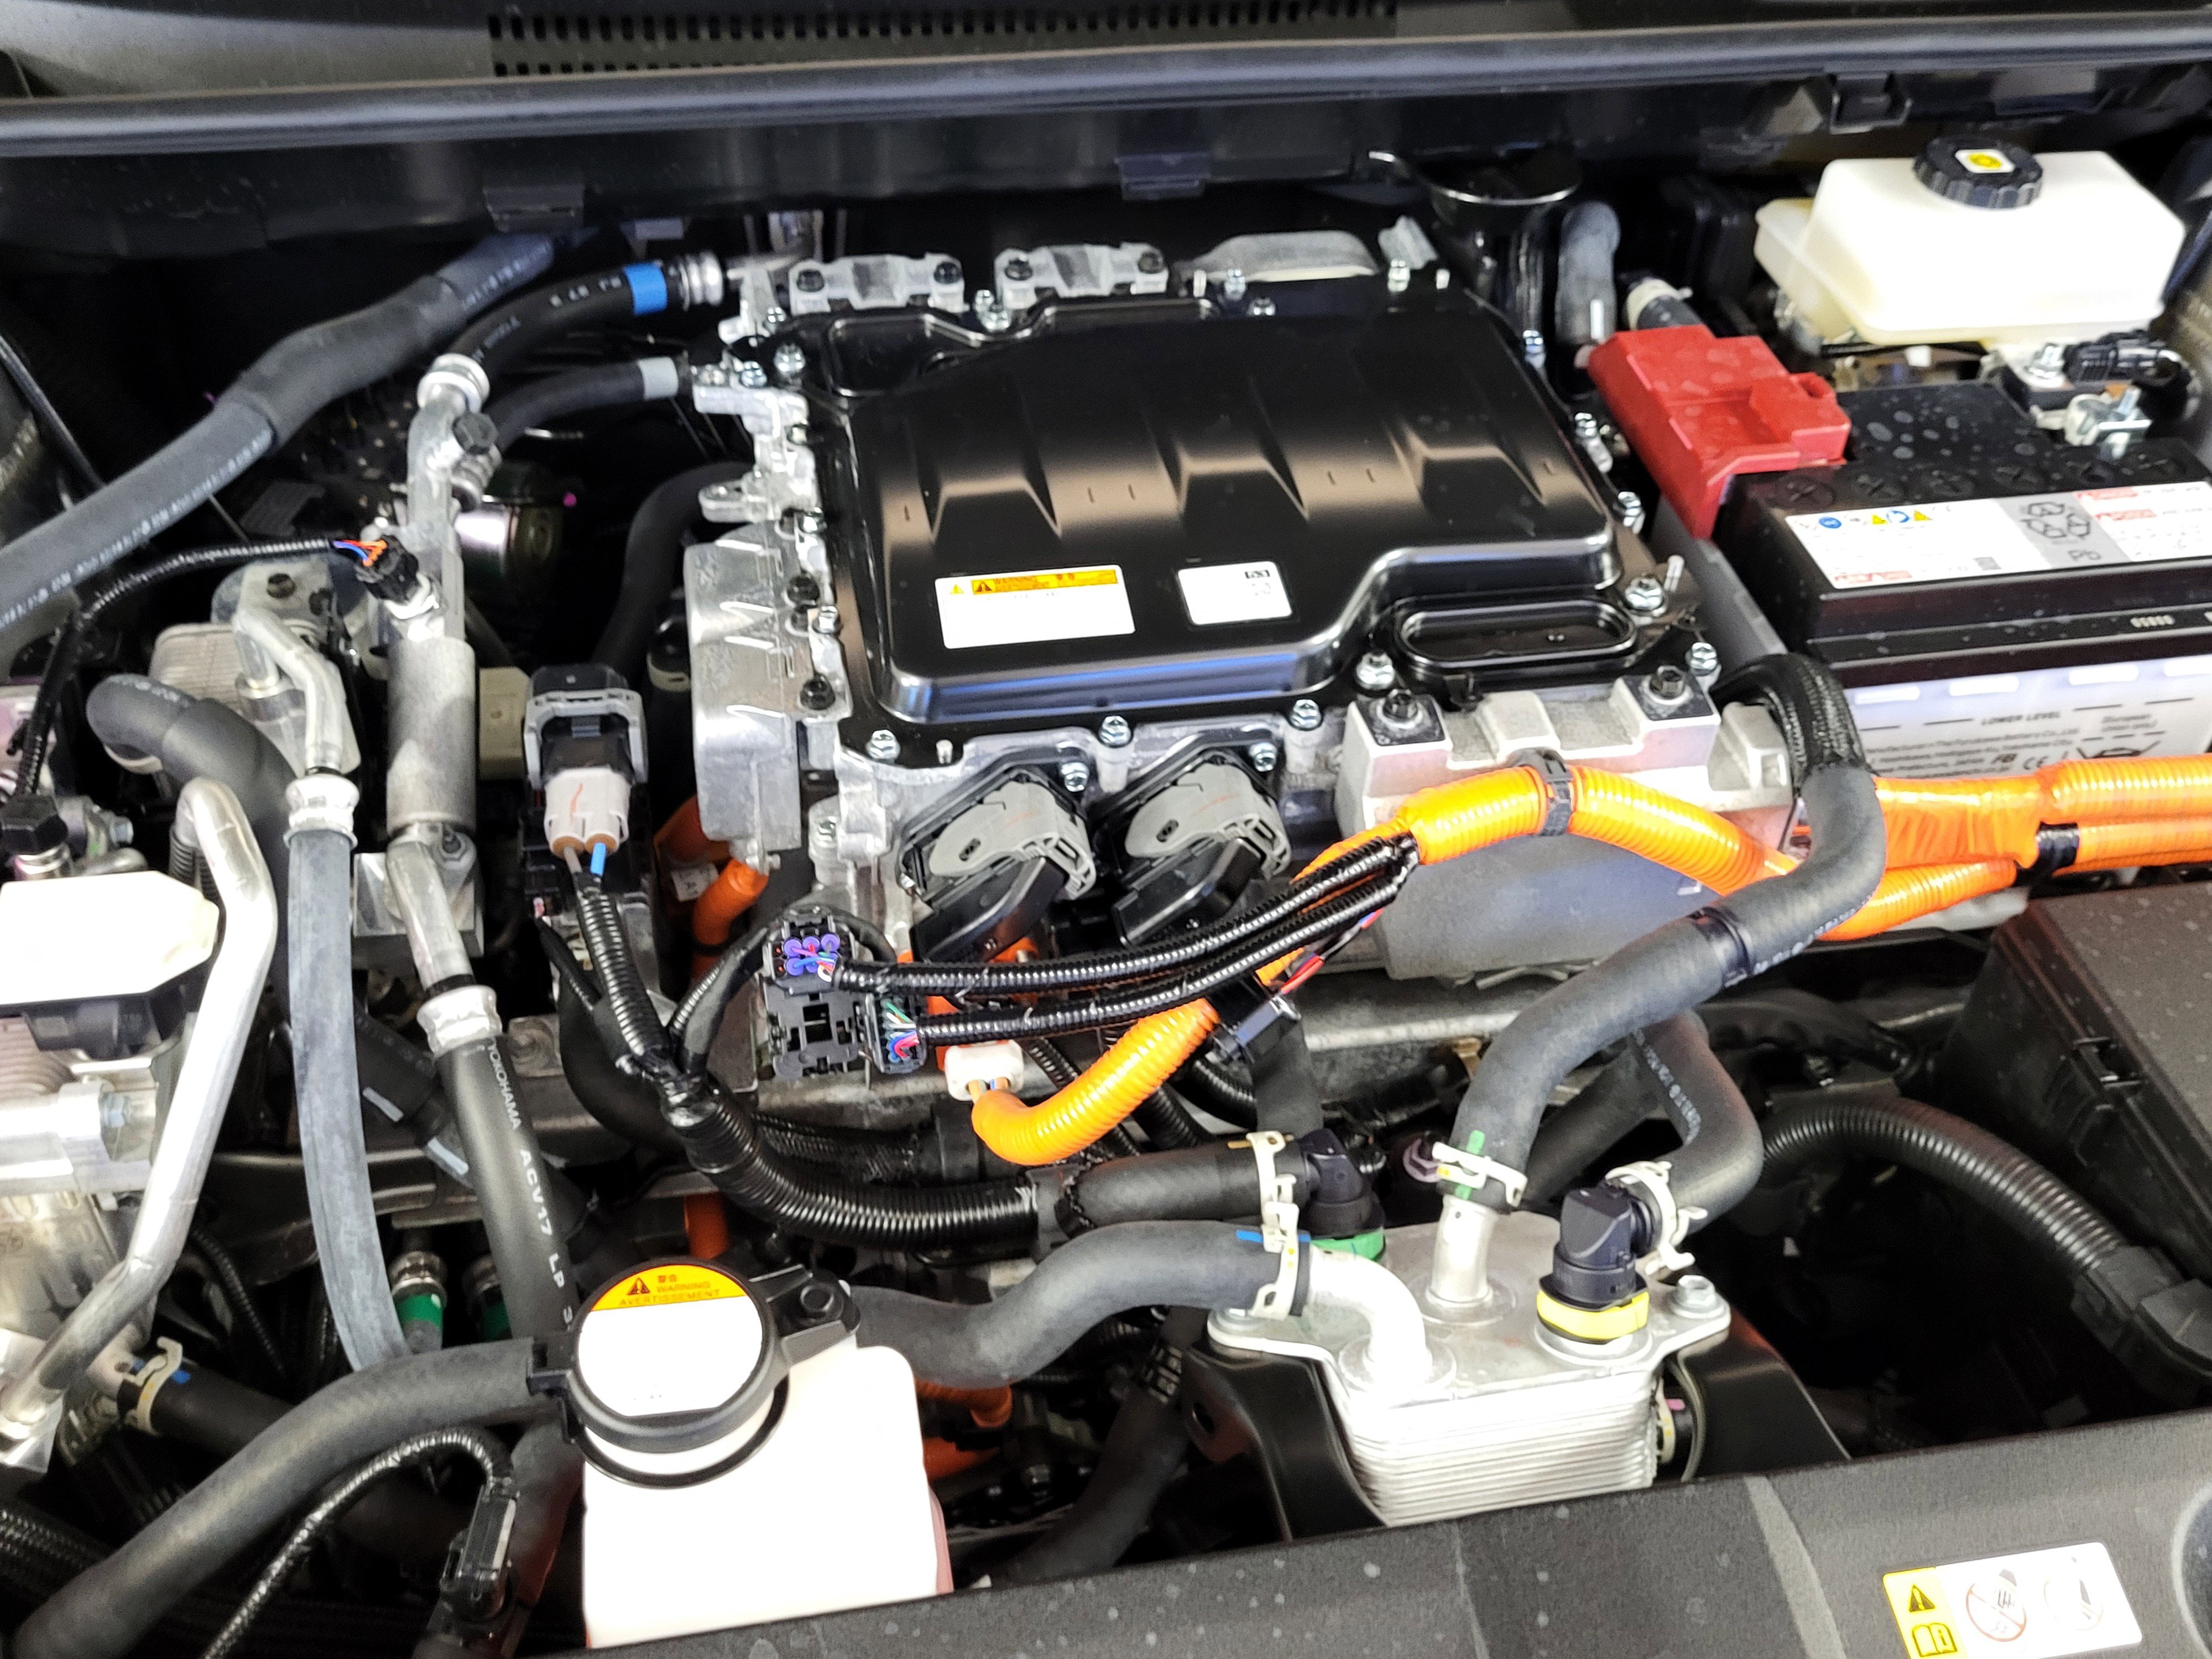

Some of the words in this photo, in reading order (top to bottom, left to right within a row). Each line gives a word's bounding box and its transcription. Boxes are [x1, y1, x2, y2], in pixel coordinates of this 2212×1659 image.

[488, 1036, 522, 1130] YOKOHAMA
[520, 1149, 552, 1236] ACV17
[549, 1252, 565, 1288] LP
[657, 1281, 711, 1292] WARNING
[620, 1290, 719, 1305] AVERTISSEMENT
